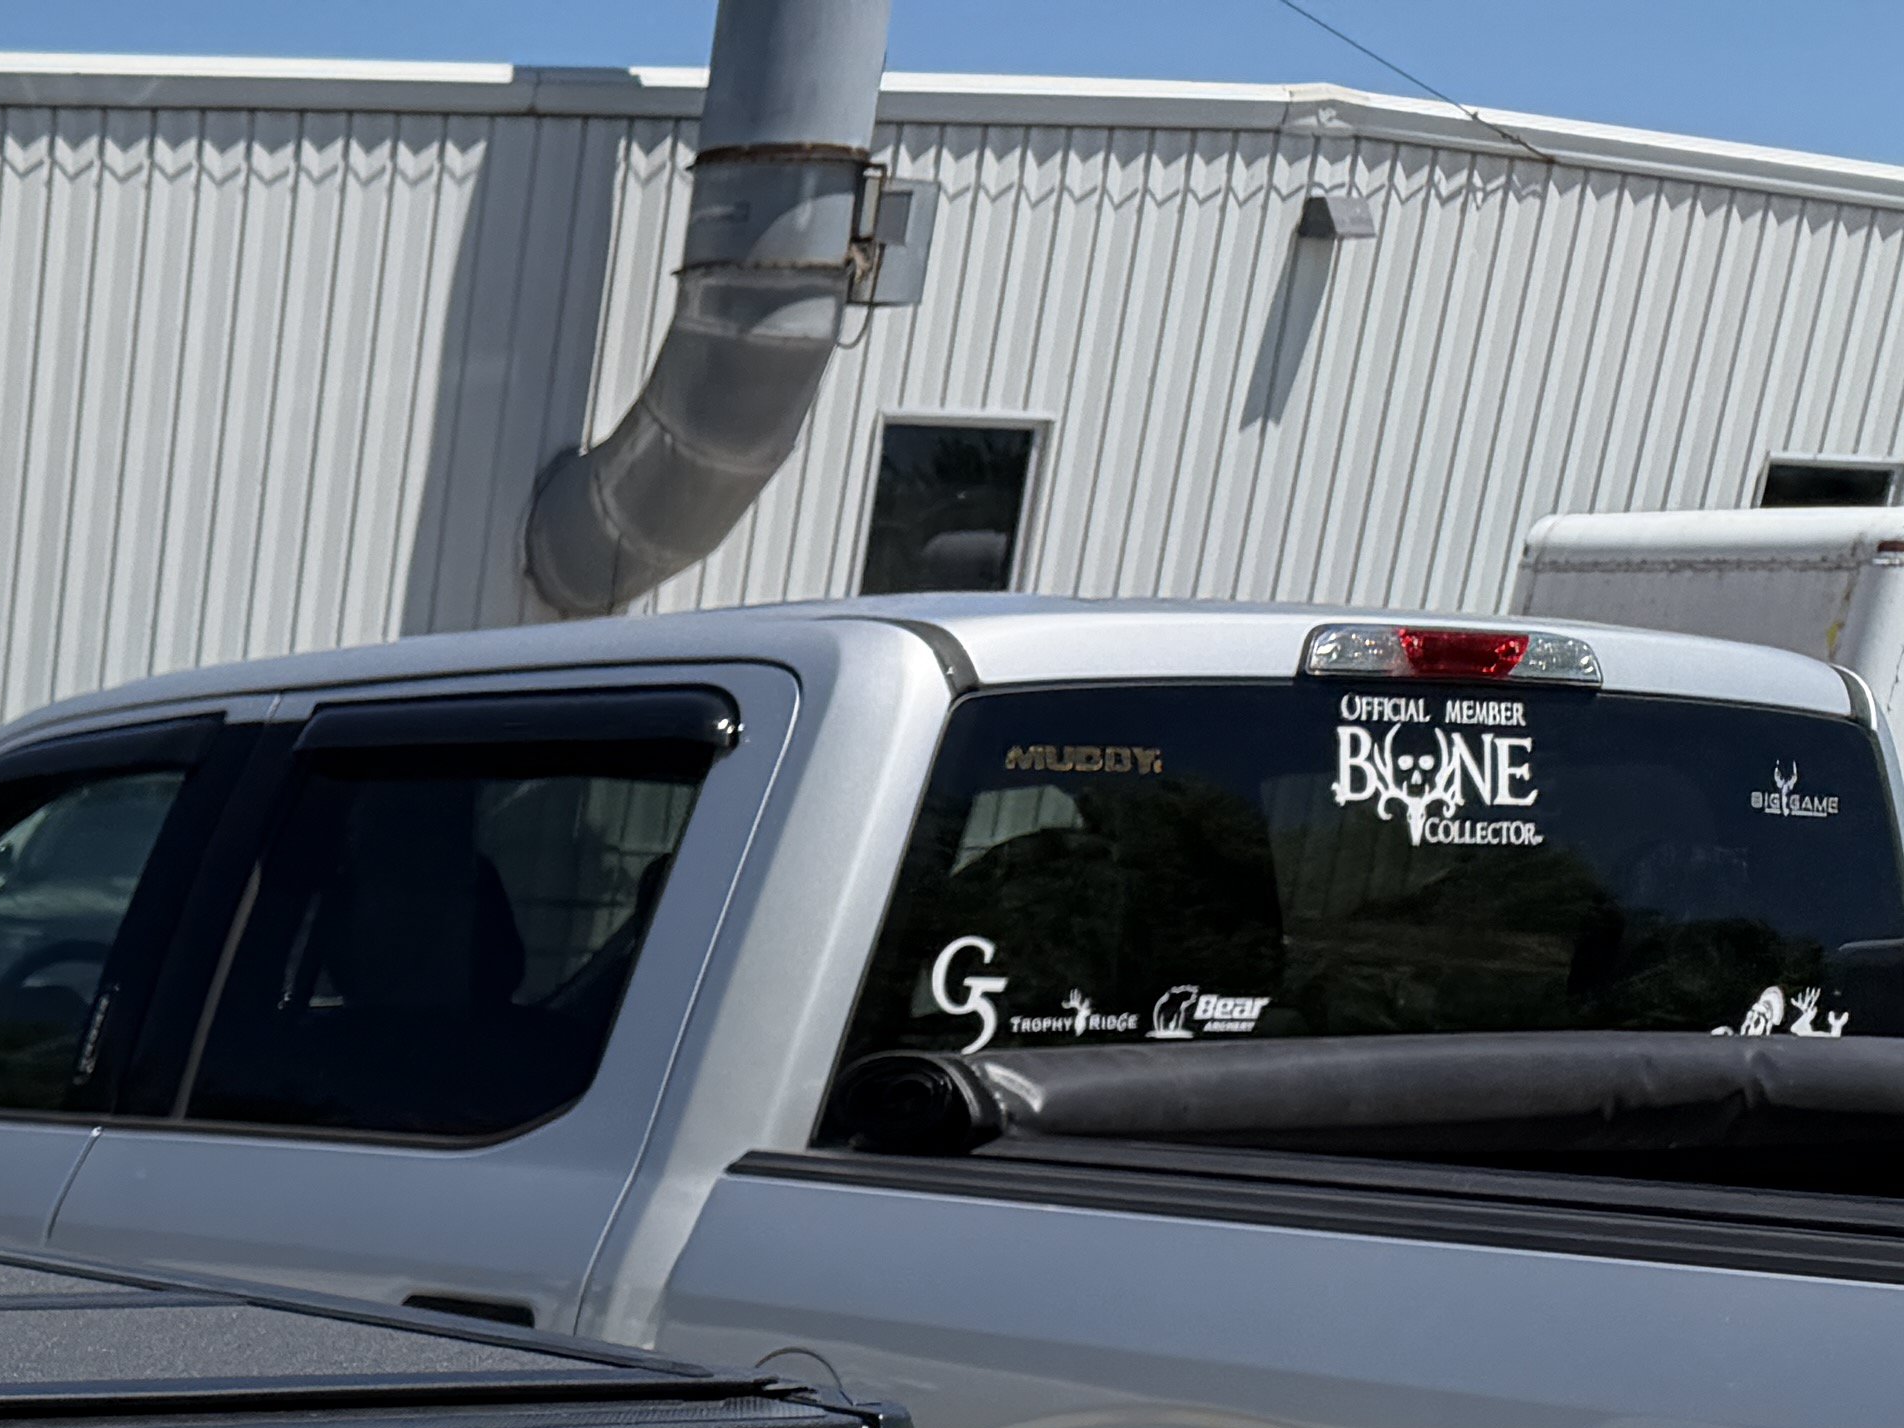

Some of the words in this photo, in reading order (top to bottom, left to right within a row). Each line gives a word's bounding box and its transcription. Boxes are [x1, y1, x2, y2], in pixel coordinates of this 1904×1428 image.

[1340, 692, 1432, 723] OFFICIAL
[1445, 699, 1528, 727] MEMBER
[1004, 744, 1159, 775] MUDDY
[1750, 791, 1780, 811] BIG
[1789, 794, 1840, 815] GAME
[1193, 994, 1271, 1021] Bear
[1010, 1014, 1073, 1033] TROPHY
[1088, 1012, 1141, 1033] RIDGE
